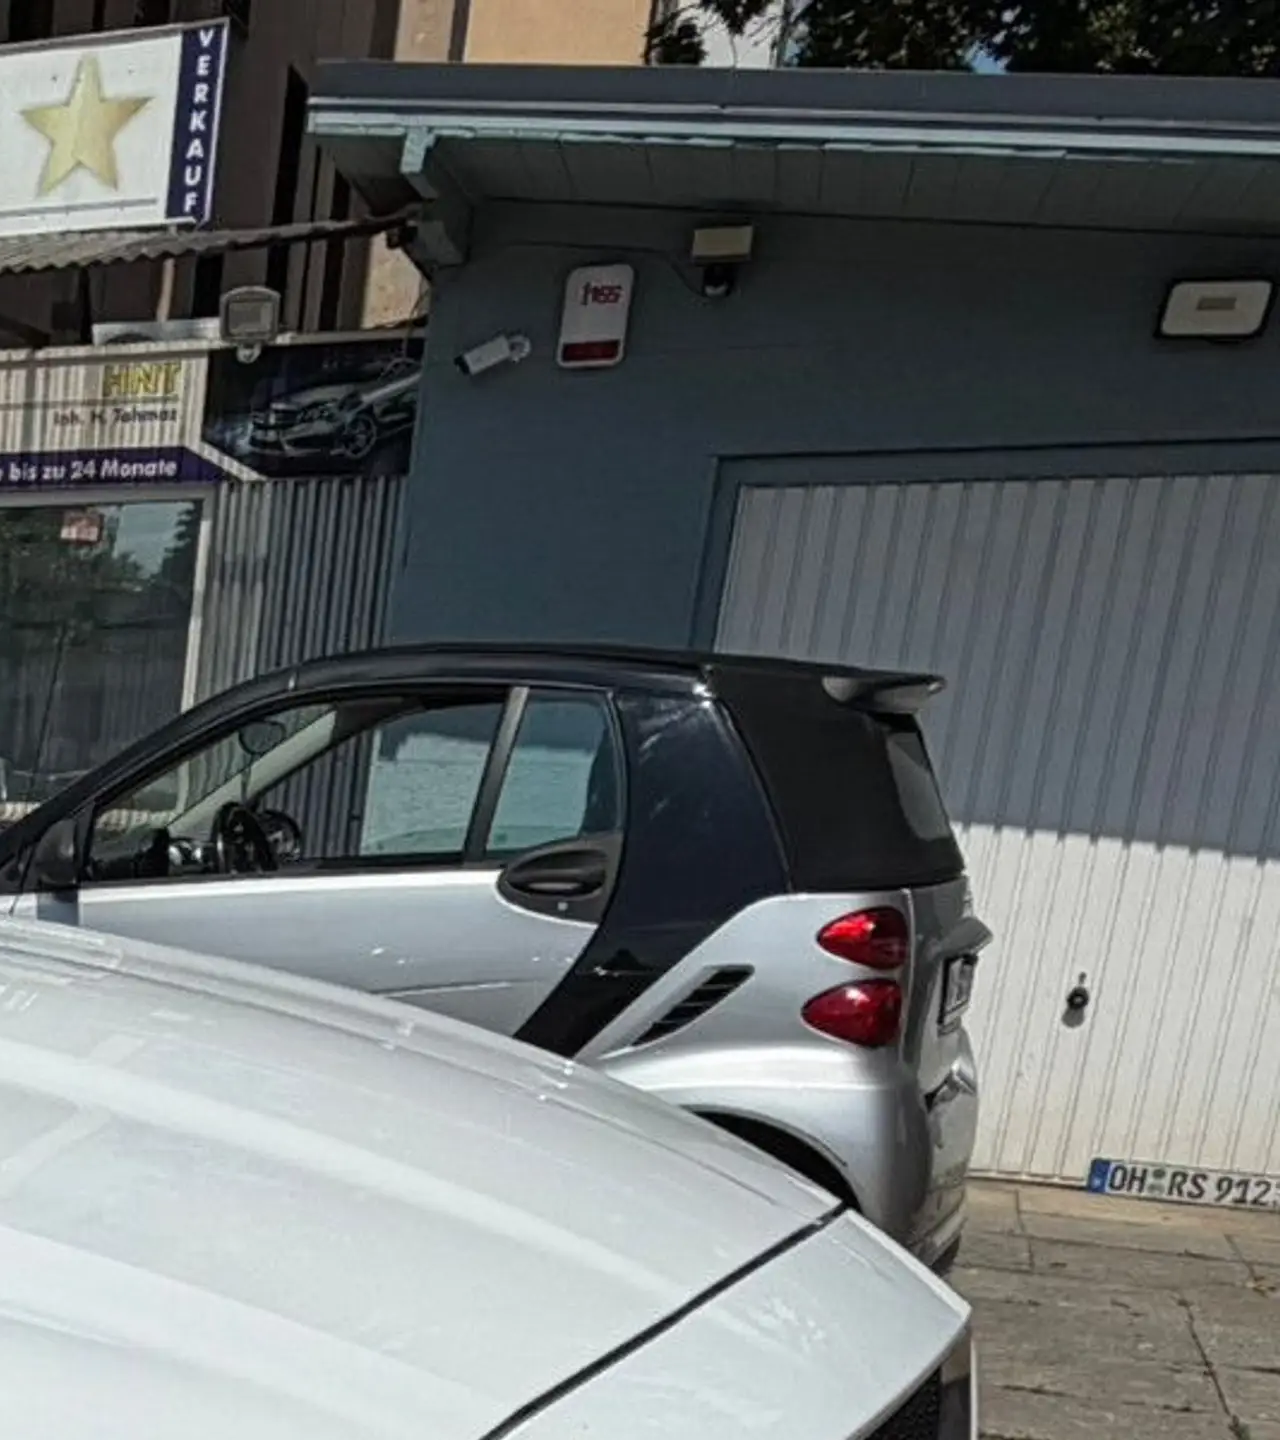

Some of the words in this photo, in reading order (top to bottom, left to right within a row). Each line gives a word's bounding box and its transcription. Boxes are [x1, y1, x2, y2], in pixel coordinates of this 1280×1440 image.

[184, 28, 215, 213] VERKAUF
[8, 462, 37, 482] bis
[41, 465, 66, 481] zu
[69, 459, 97, 480] 24
[99, 458, 178, 478] Monate
[1108, 1164, 1148, 1194] OH
[1166, 1170, 1208, 1200] RS
[1213, 1176, 1280, 1206] 912
